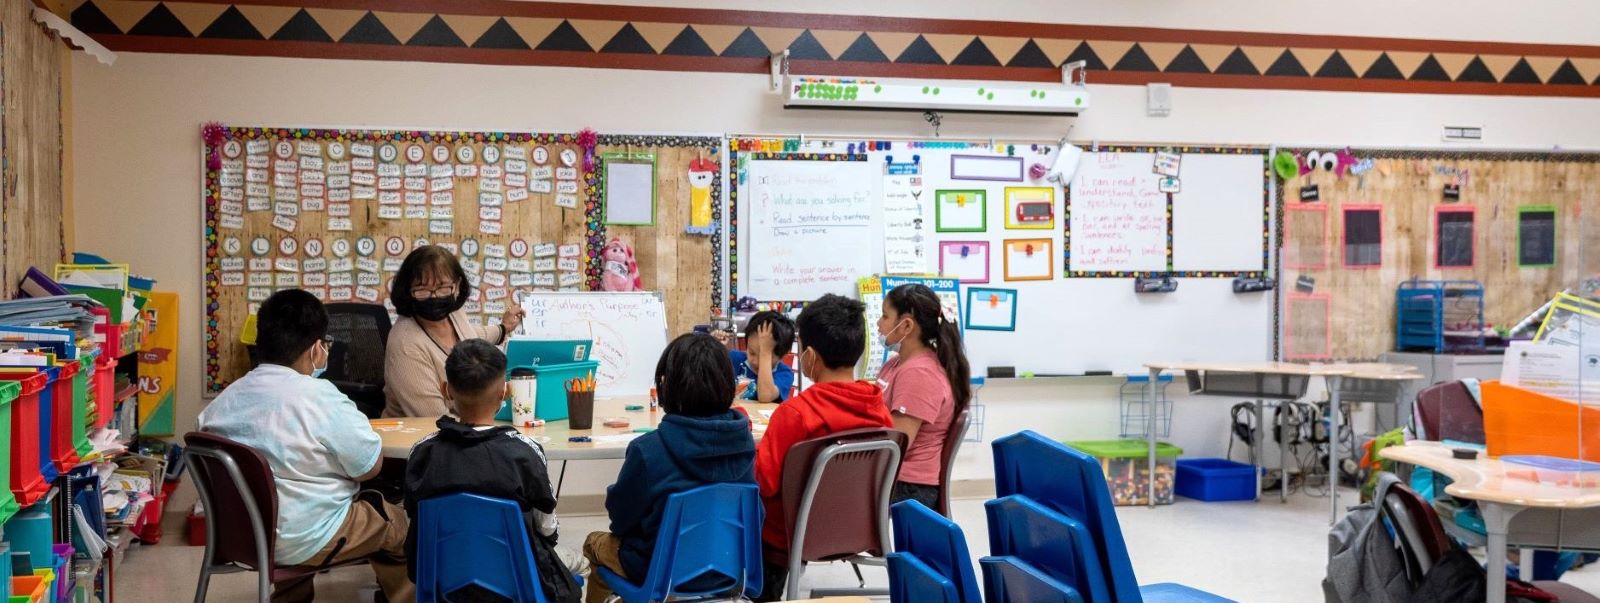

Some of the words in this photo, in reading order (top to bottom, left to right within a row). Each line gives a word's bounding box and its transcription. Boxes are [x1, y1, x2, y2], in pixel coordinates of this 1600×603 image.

[227, 143, 237, 153] A
[280, 144, 289, 155] B
[332, 144, 341, 155] C
[384, 147, 393, 158] D
[411, 147, 420, 159] E
[461, 148, 470, 158] G
[437, 148, 446, 160] F
[488, 150, 495, 159] H
[537, 150, 544, 160] I
[831, 212, 842, 222] by
[228, 242, 238, 251] K
[256, 240, 265, 252] L
[283, 241, 294, 251] M
[309, 244, 319, 253] N
[337, 241, 346, 251] O
[390, 239, 399, 251] Q
[465, 243, 473, 254] T
[514, 243, 524, 253] U
